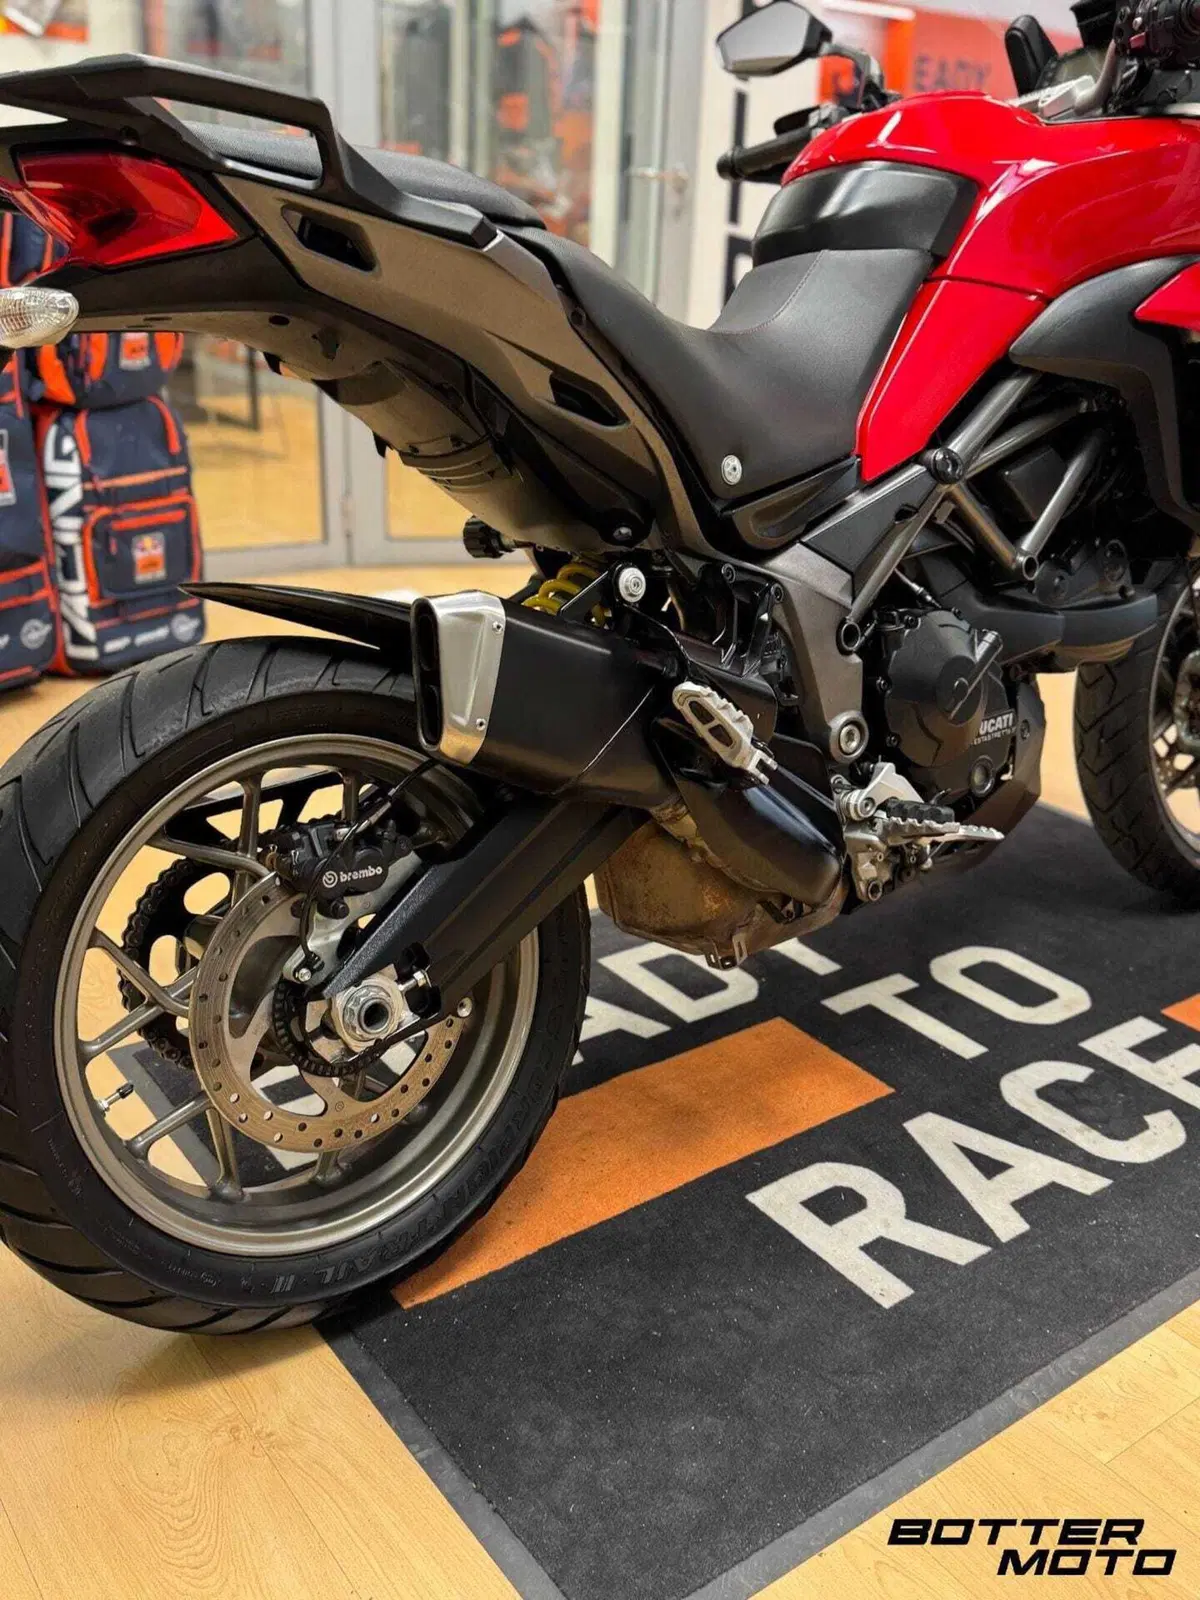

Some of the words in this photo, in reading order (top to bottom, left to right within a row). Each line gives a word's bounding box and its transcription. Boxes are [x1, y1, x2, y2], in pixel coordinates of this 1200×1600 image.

[979, 713, 1014, 736] UCATI
[340, 866, 383, 883] brembo
[820, 946, 1092, 1060] TO
[745, 1016, 1200, 1309] RACE
